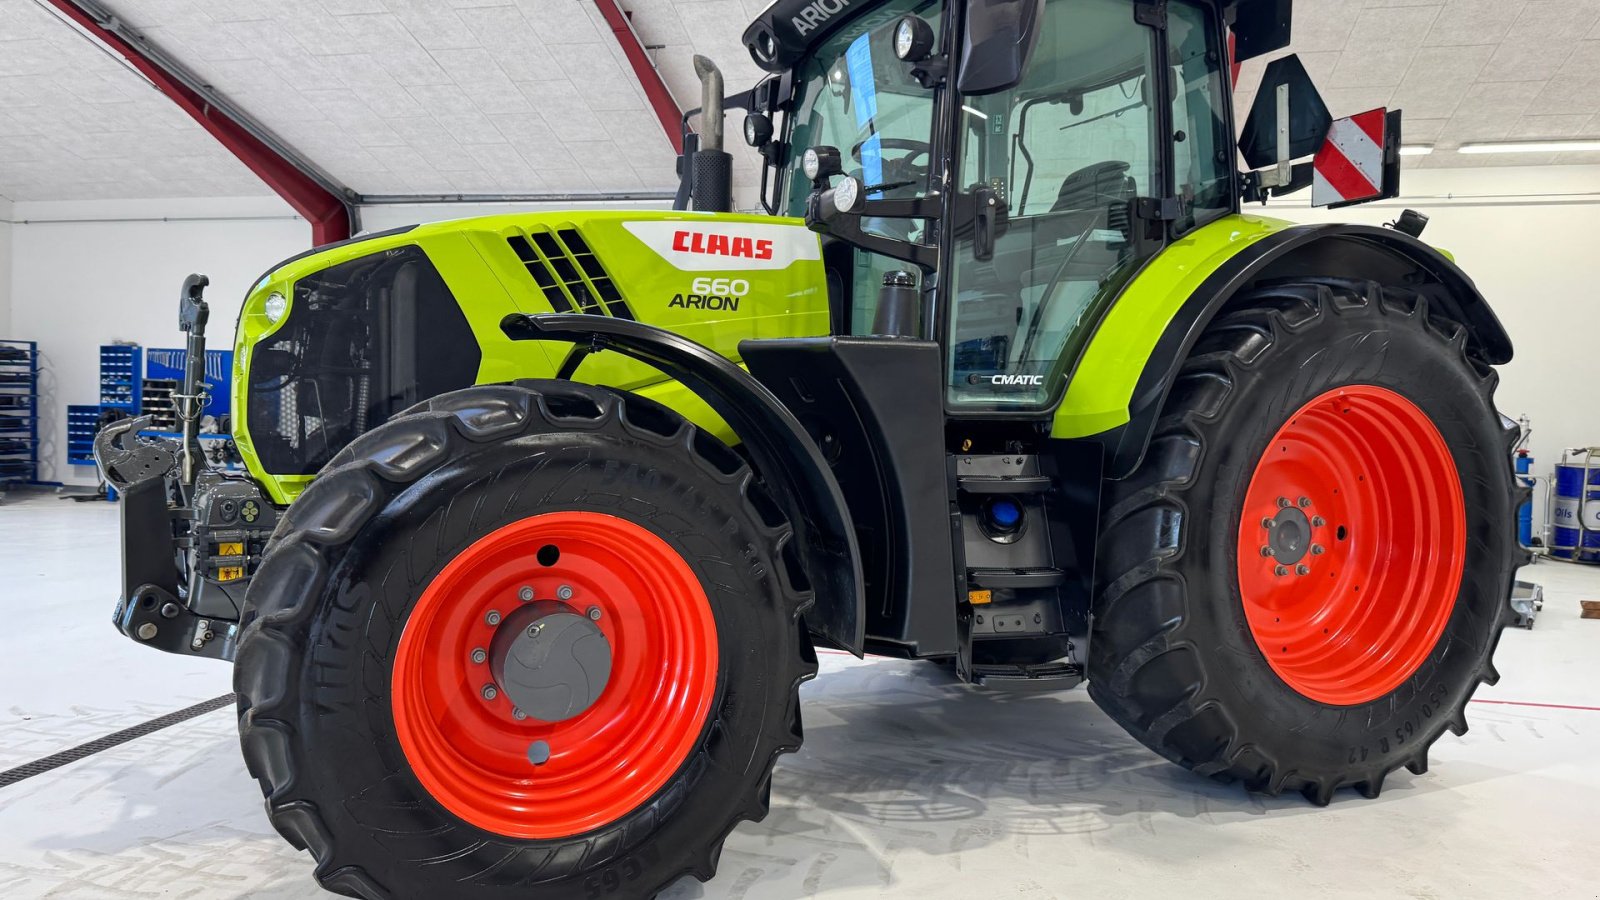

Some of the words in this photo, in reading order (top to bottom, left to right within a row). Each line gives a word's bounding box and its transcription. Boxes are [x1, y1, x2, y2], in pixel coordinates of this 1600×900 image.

[672, 230, 773, 260] CLAAS
[692, 277, 750, 296] 660
[668, 293, 739, 311] ARION
[991, 374, 1044, 385] CMATIC
[1395, 683, 1449, 745] 650/65
[1378, 736, 1390, 754] R
[1347, 745, 1369, 765] 42
